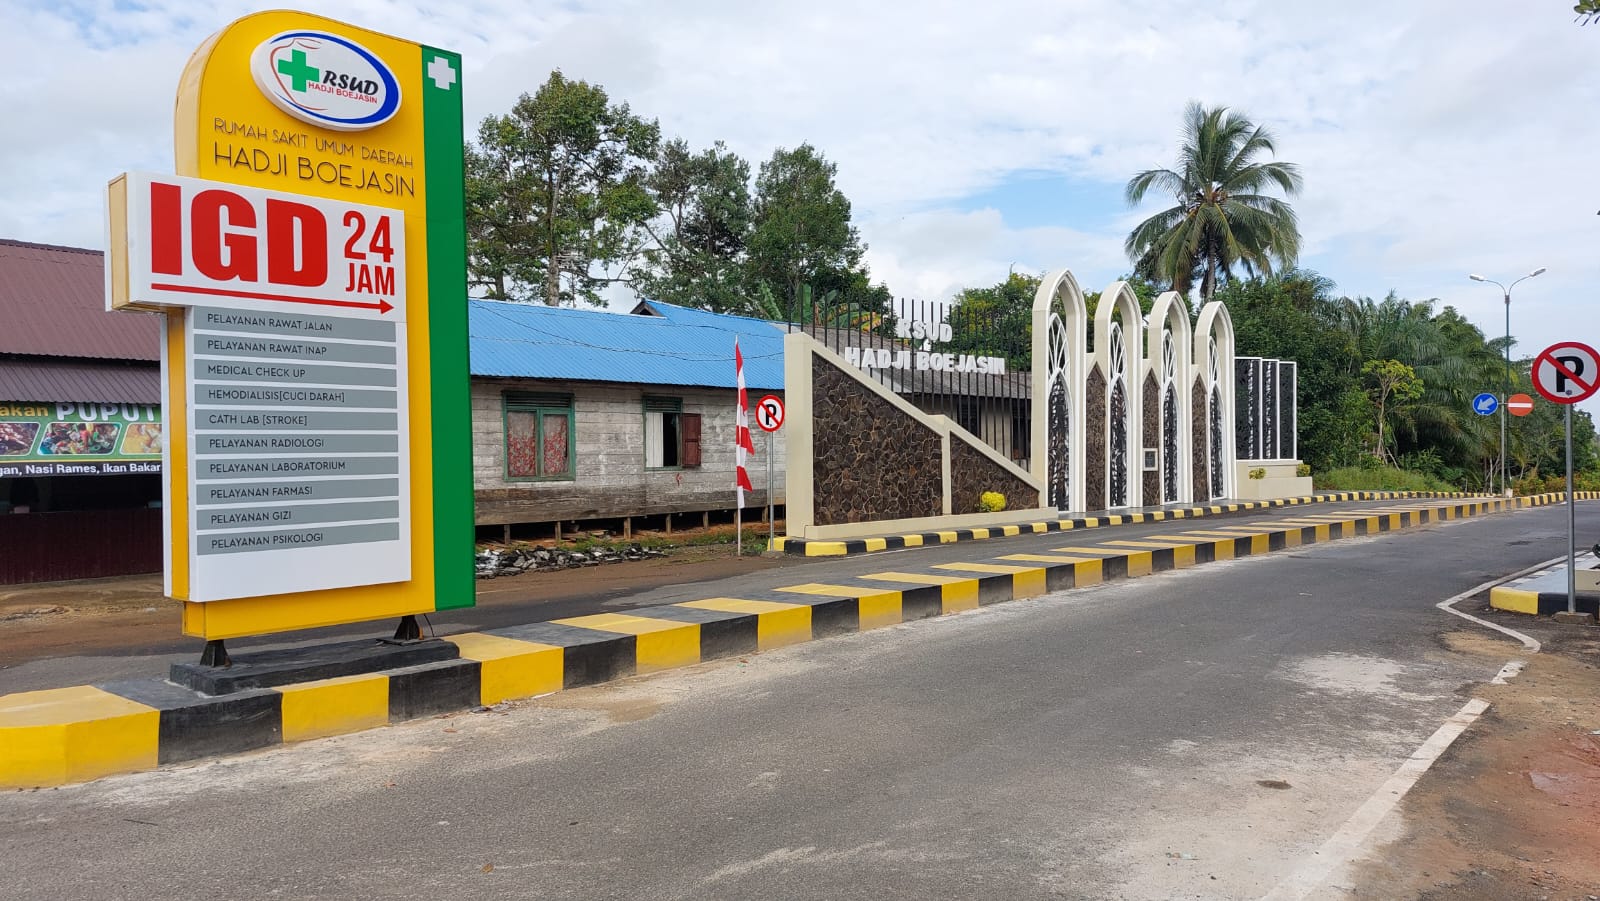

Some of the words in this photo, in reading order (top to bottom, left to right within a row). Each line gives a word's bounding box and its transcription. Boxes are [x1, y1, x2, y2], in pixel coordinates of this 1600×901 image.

[308, 81, 334, 94] HADJI
[336, 88, 378, 104] BOEJASIN
[323, 70, 379, 96] RSUD
[214, 117, 268, 139] RUMAH
[272, 129, 309, 148] SAKIT
[315, 137, 355, 157] UMUM
[361, 146, 414, 169] DAERAH
[214, 141, 288, 176] HADJI
[297, 155, 415, 198] BOEJASIN
[150, 181, 328, 288] IGD
[343, 210, 394, 263] 24
[345, 263, 395, 296] JAM
[207, 313, 266, 326] PELAYANAN
[268, 318, 302, 330] RAWAT
[304, 321, 333, 332] JALAN
[895, 317, 953, 342] RSUD
[207, 340, 266, 352] PELAYANAN
[269, 344, 303, 354] RAWAT
[305, 346, 327, 356] INAP
[207, 364, 254, 376] MEDICAL
[255, 367, 290, 378] CHECK
[293, 369, 306, 378] UP
[844, 347, 911, 370] HADJI
[916, 352, 1006, 376] BOEJASIN
[309, 392, 345, 403] DARAH]
[55, 402, 155, 421] PUPUT
[209, 414, 237, 425] CATH
[240, 415, 260, 425] LAB
[262, 415, 308, 427] [STROKE]
[209, 438, 268, 448] PELAYANAN
[271, 438, 325, 448] RADIOLOGI
[25, 464, 53, 474] Nasi
[56, 464, 100, 474] Rames,
[129, 463, 161, 473] Bakar
[210, 463, 269, 473] PELAYANAN
[271, 461, 346, 472] LABORATORIUM
[210, 487, 269, 499] PELAYANAN
[272, 486, 313, 497] FARMASI
[211, 512, 270, 524] PELAYANAN
[272, 511, 292, 521] GIZI
[211, 535, 270, 549] PELAYANAN
[273, 533, 324, 545] PSIKOLOGI
